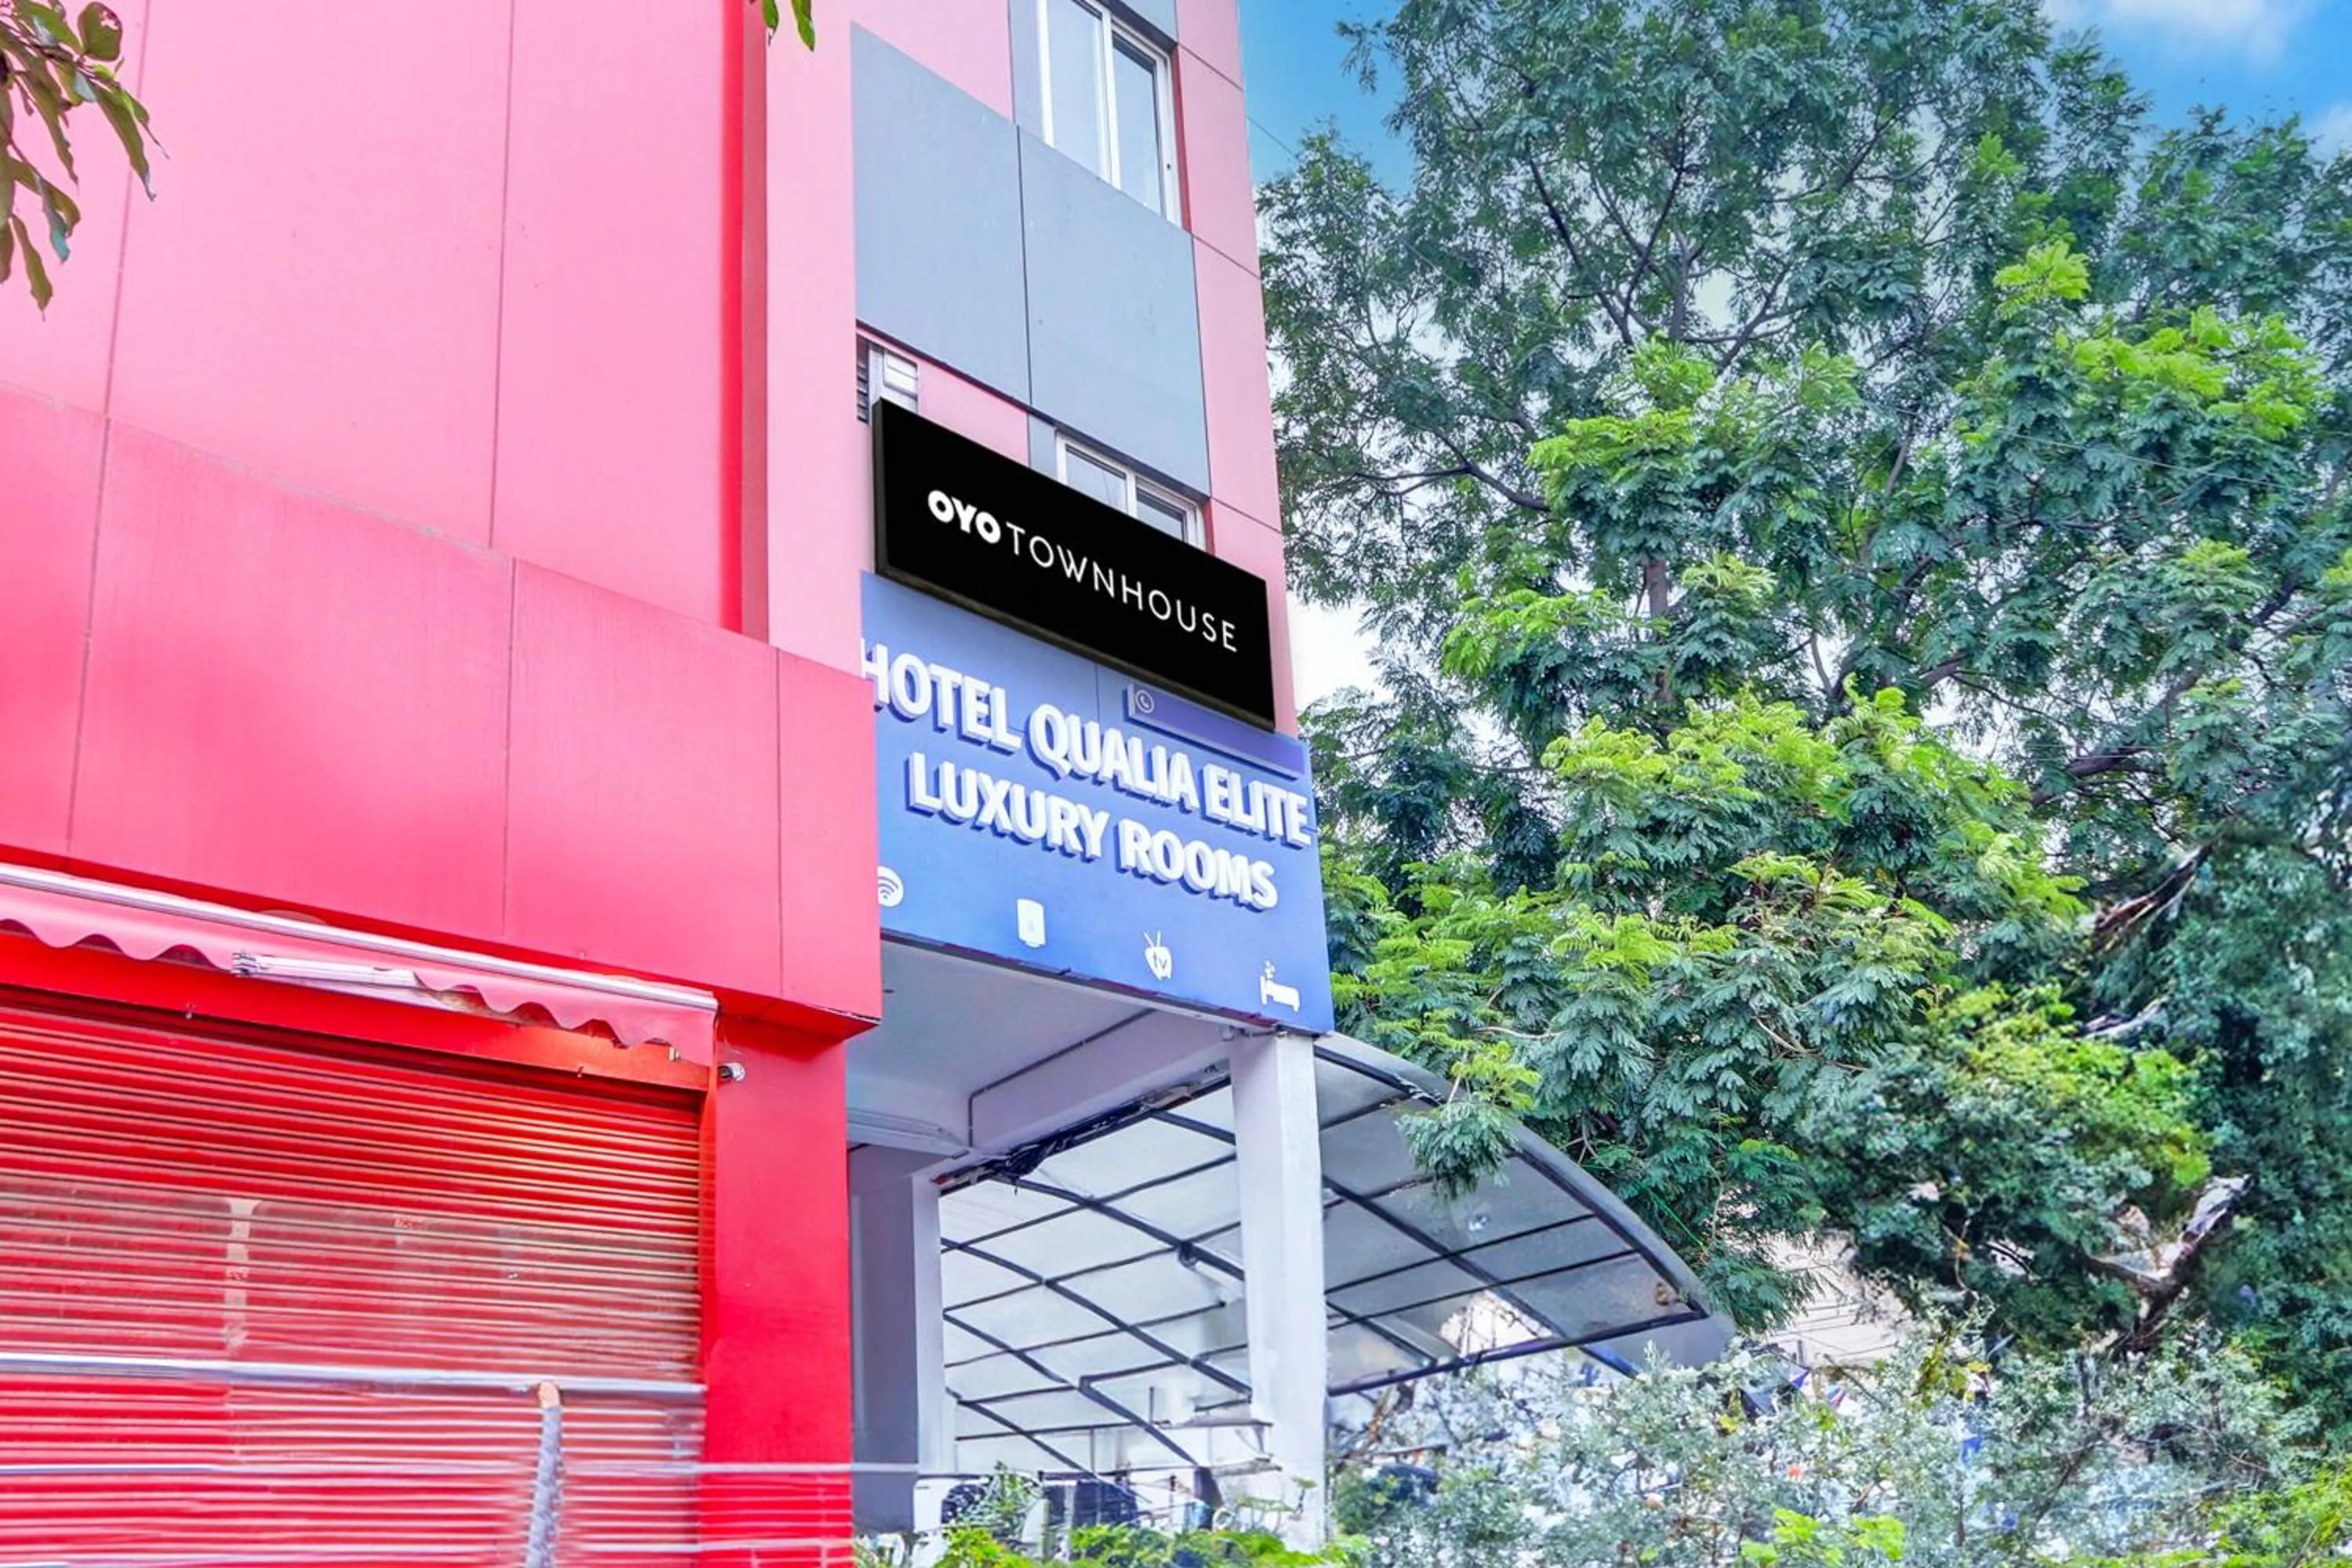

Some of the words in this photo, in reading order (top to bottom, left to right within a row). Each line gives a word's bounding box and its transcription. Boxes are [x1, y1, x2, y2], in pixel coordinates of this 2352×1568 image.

[927, 489, 1001, 544] OYO
[1006, 521, 1238, 653] TOWNHOUSE
[859, 637, 1022, 750] HOTEL
[1029, 703, 1200, 812] QUALIA
[1203, 763, 1312, 848] ELITE
[909, 752, 1110, 859] LUXURY
[1117, 818, 1278, 910] ROOMS
